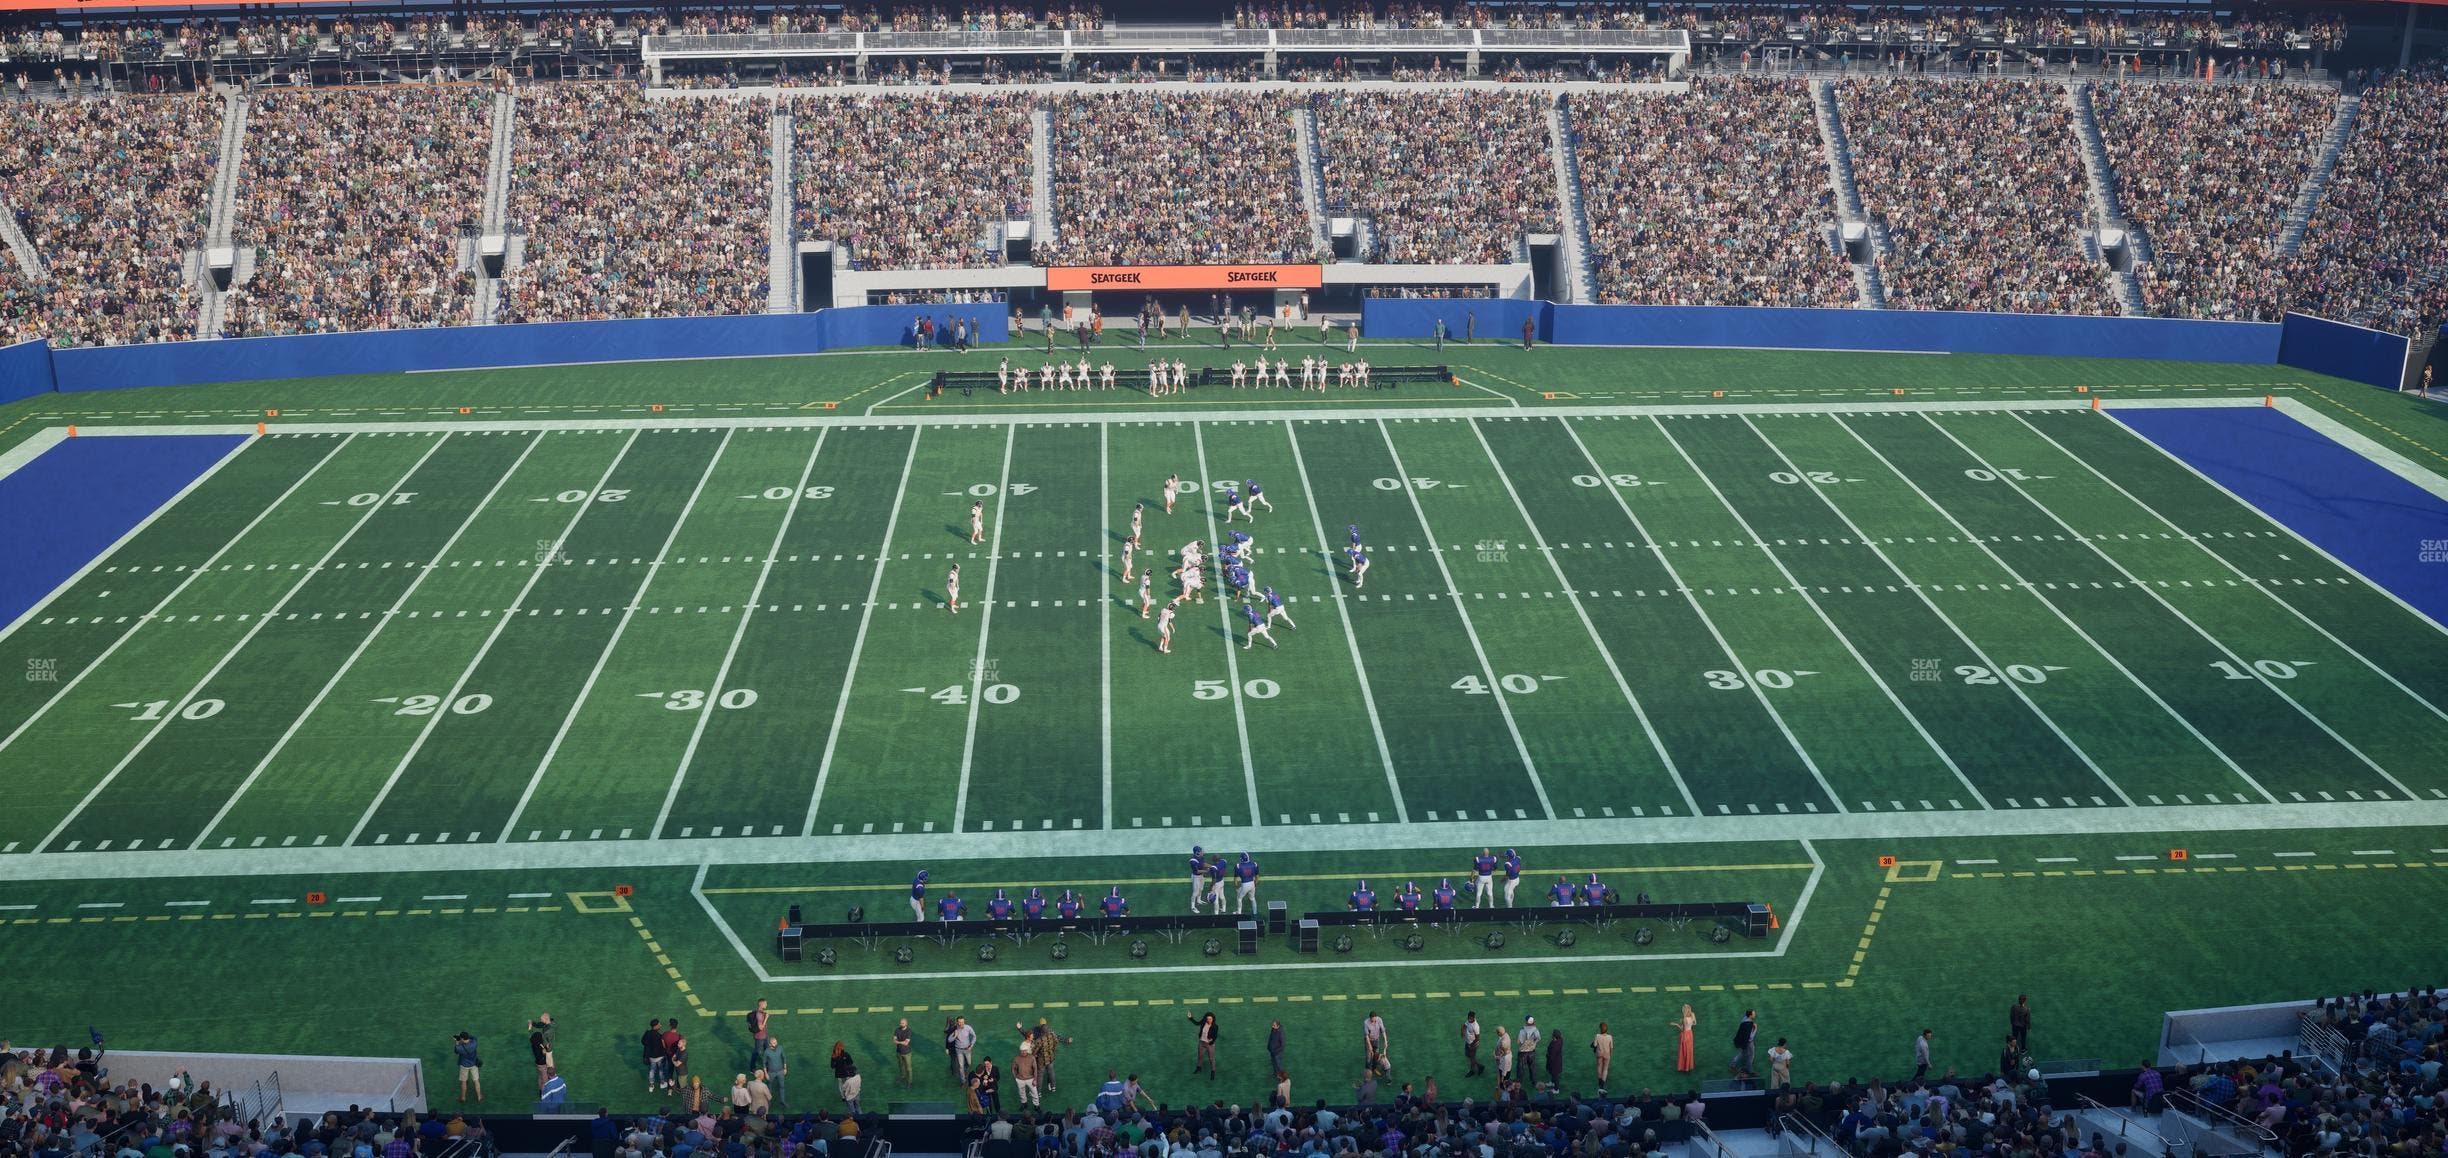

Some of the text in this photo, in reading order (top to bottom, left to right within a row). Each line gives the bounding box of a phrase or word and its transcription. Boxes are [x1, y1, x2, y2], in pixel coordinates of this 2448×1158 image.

[1091, 272, 1141, 284] SEATGEEK
[1227, 271, 1277, 283] SEATGEEK
[1372, 477, 1441, 490] 40
[1571, 474, 1642, 487] 30
[1768, 471, 1841, 484] 20
[556, 489, 632, 503] 20
[763, 486, 835, 500] 30
[968, 483, 1039, 497] 40
[1954, 665, 2047, 685] 20
[2209, 660, 2298, 680] 10
[1450, 674, 1539, 695] 40
[1703, 670, 1794, 690] 30
[930, 684, 1021, 705] 40
[1192, 679, 1281, 701] 50
[394, 694, 493, 716] 20
[664, 689, 759, 711] 30
[130, 699, 226, 721] 10
[1882, 857, 1892, 866] 30
[2174, 850, 2183, 859] 20
[619, 886, 629, 895] 30
[311, 894, 320, 903] 20
